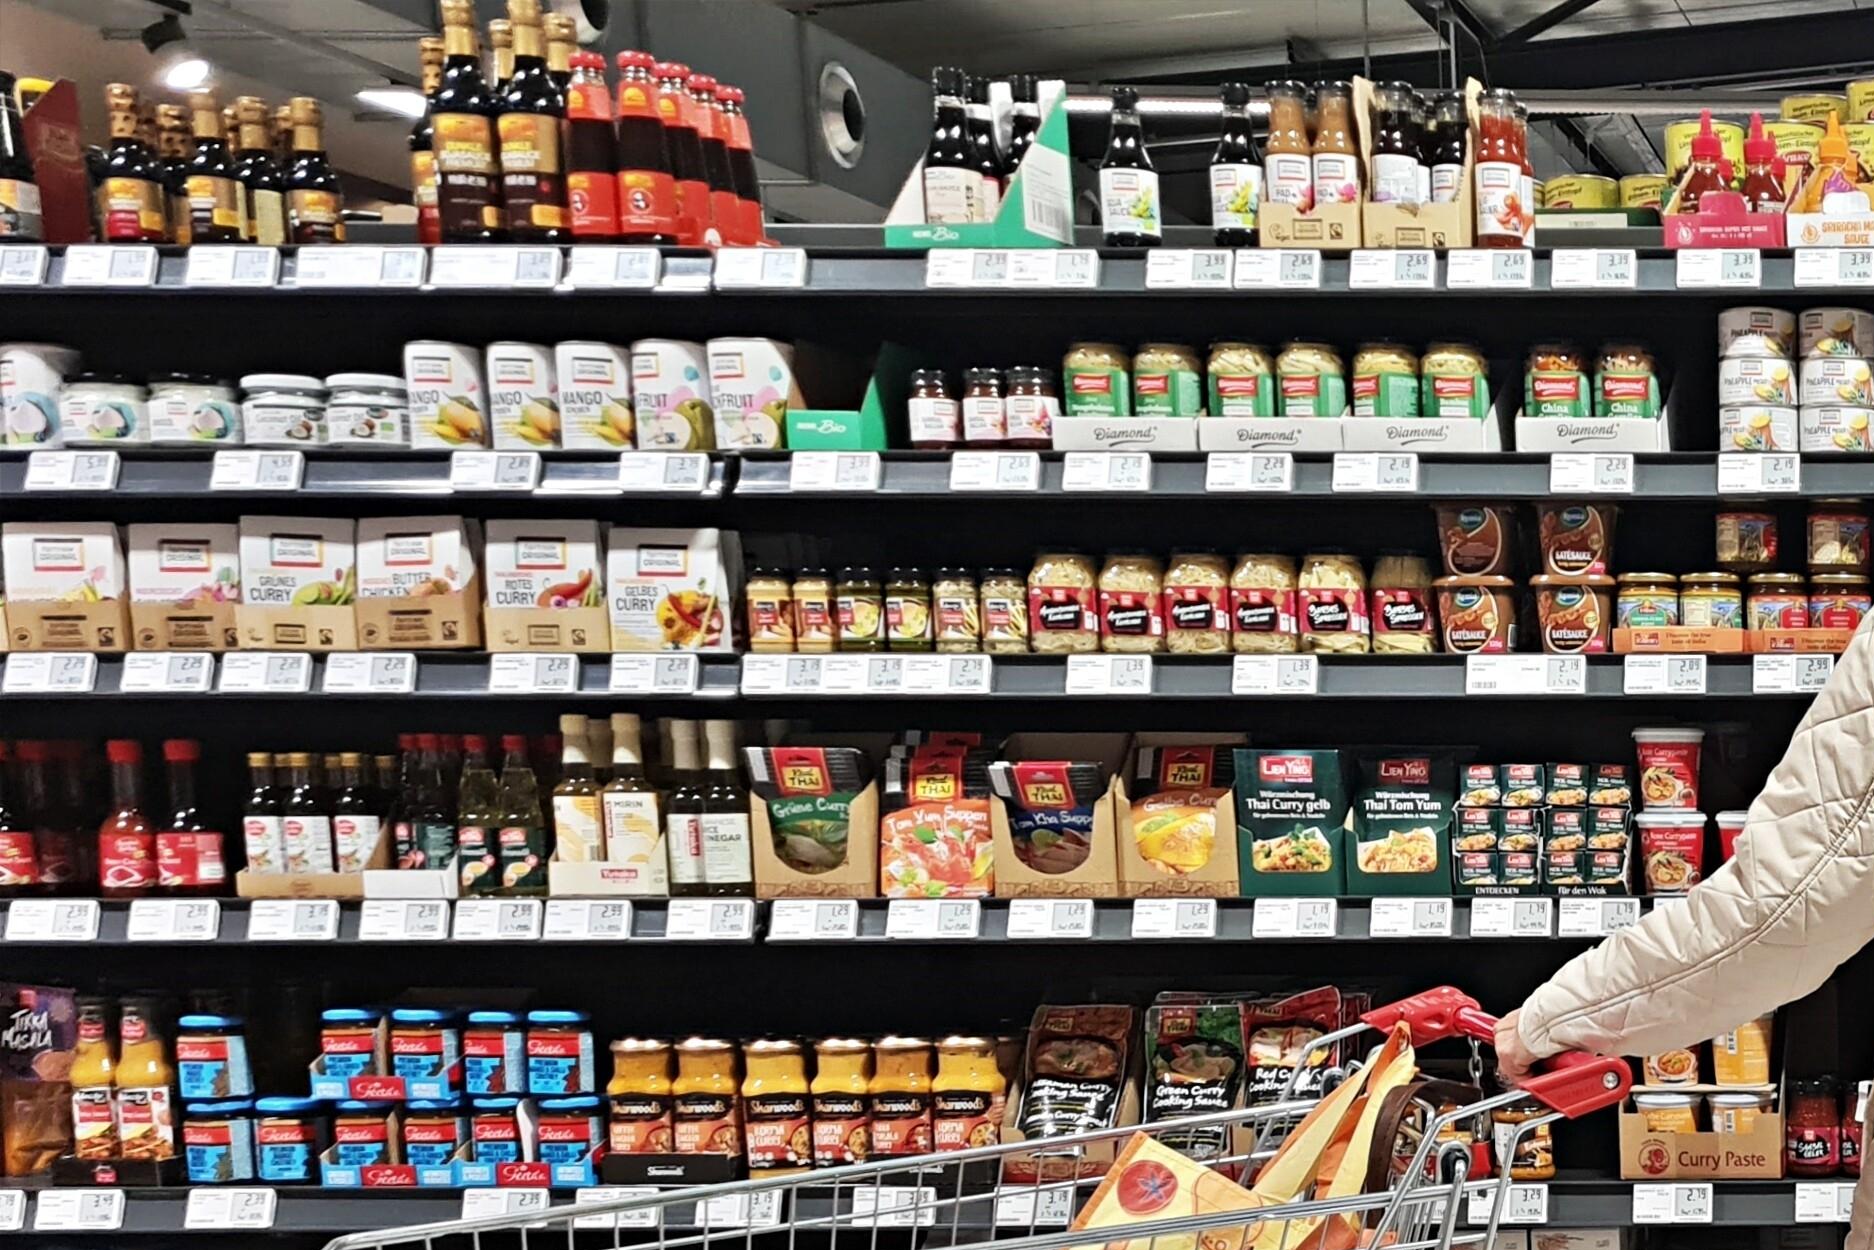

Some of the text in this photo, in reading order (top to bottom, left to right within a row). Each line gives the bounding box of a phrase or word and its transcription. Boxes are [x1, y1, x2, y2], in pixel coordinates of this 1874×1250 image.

[1822, 221, 1860, 232] SRIRACHA
[932, 227, 960, 241] Bio
[1844, 233, 1870, 244] SAUCE
[1541, 403, 1568, 413] China
[1611, 403, 1638, 413] China
[818, 419, 847, 433] Bio
[1094, 427, 1157, 445] Diamond
[1237, 428, 1300, 446] Diamond
[1386, 426, 1448, 443] Diamond
[1557, 424, 1619, 442] Diamond
[392, 572, 432, 587] BUTTER
[505, 579, 533, 592] ROTES
[250, 587, 292, 601] CURRY
[625, 585, 659, 598] GELBES
[495, 590, 537, 607] CURRY
[616, 598, 656, 612] CURRY
[788, 776, 820, 787] THAI
[1171, 773, 1201, 782] THAI
[919, 784, 950, 795] THAI
[615, 799, 644, 809] MIRIN
[1031, 793, 1063, 803] THAI
[773, 797, 851, 818] Grüne Curry
[1246, 798, 1331, 813] Thai Curry gelb
[1364, 799, 1442, 812] Thai Tom Yum
[915, 808, 941, 824] Yum
[944, 806, 987, 823] Suppen
[1558, 886, 1607, 895] für den Wok
[9, 1010, 49, 1032] TIKKA
[1, 1029, 52, 1049] MASALA
[1256, 1068, 1275, 1079] Red
[1156, 1085, 1225, 1097] Green Curry
[1153, 1096, 1228, 1108] Cooking Sauce
[1678, 1150, 1766, 1170] Curry Paste
